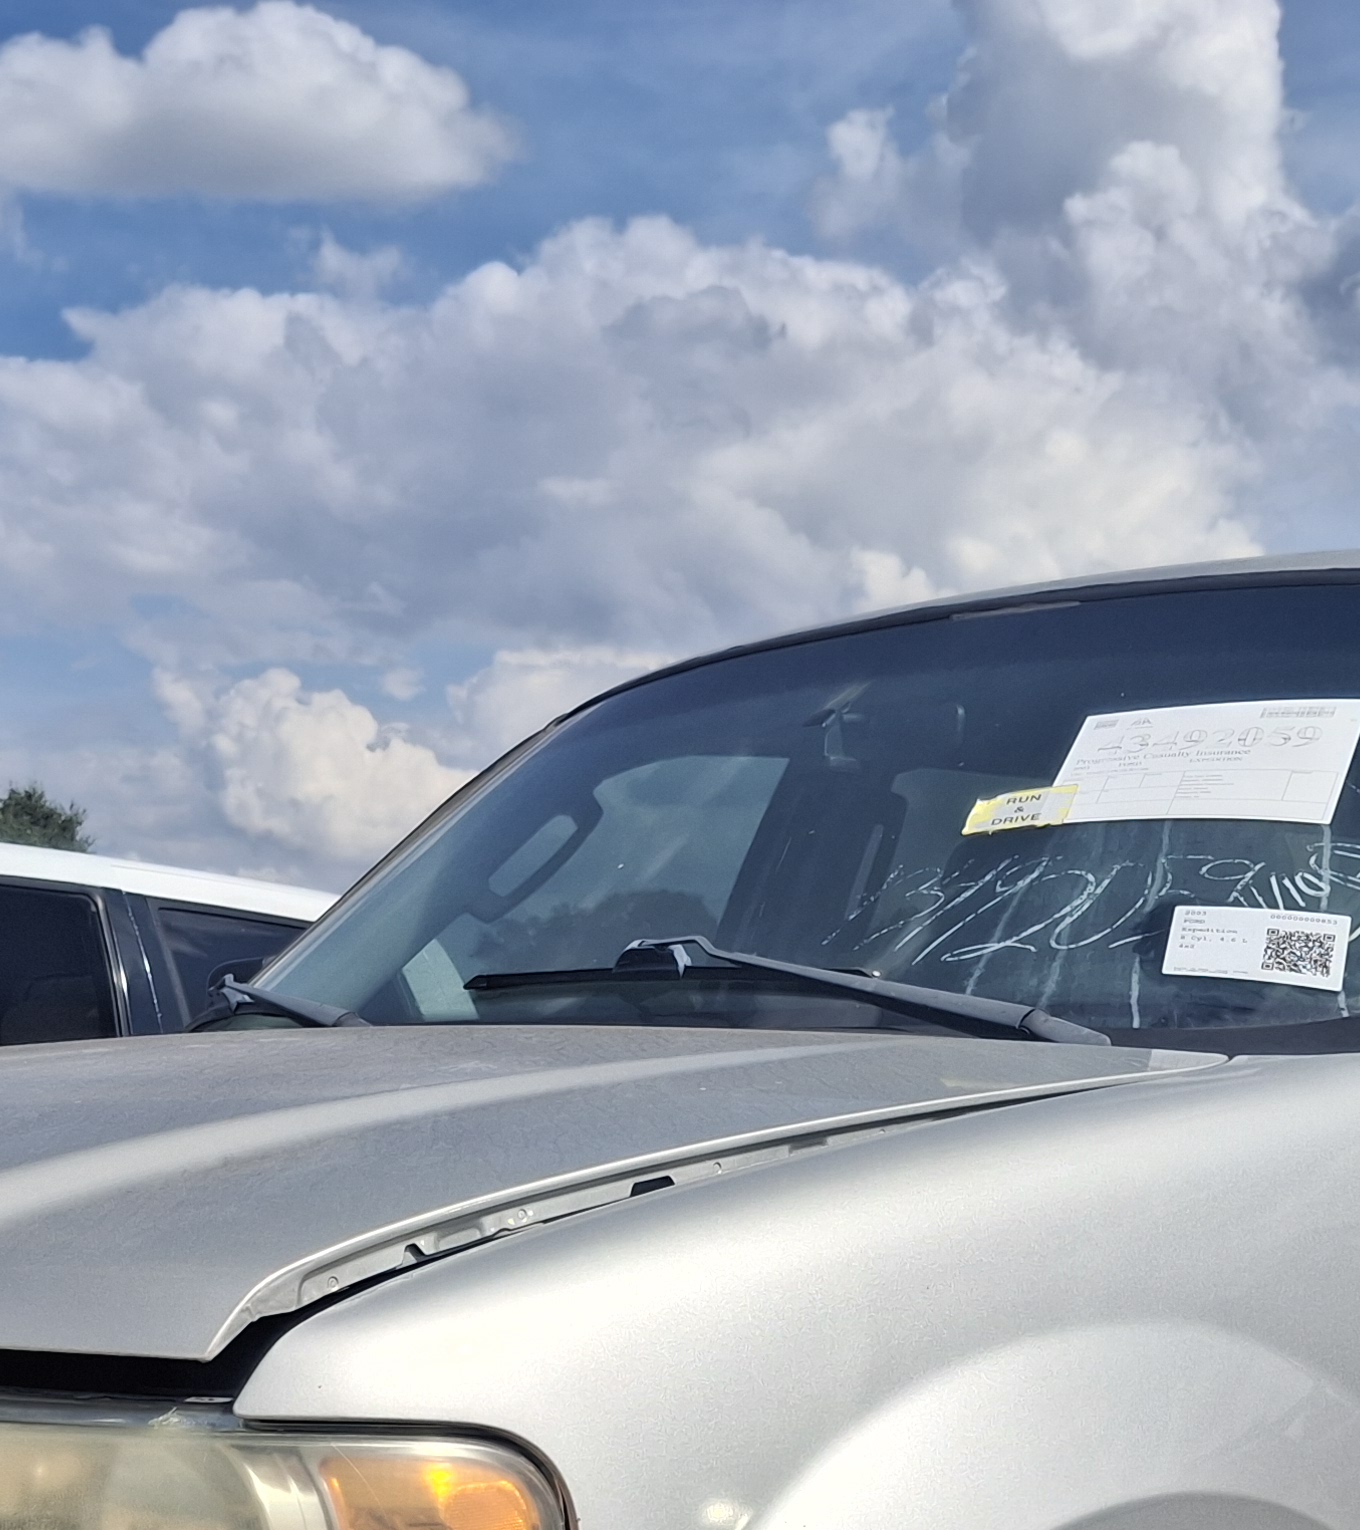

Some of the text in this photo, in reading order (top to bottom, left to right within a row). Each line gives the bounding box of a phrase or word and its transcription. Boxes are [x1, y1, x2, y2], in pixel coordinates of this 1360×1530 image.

[1097, 725, 1323, 755] 43492059
[1143, 750, 1192, 760] Casualty
[1196, 747, 1252, 757] Insurance
[1006, 794, 1042, 805] RUN
[990, 813, 1042, 826] DRIVE
